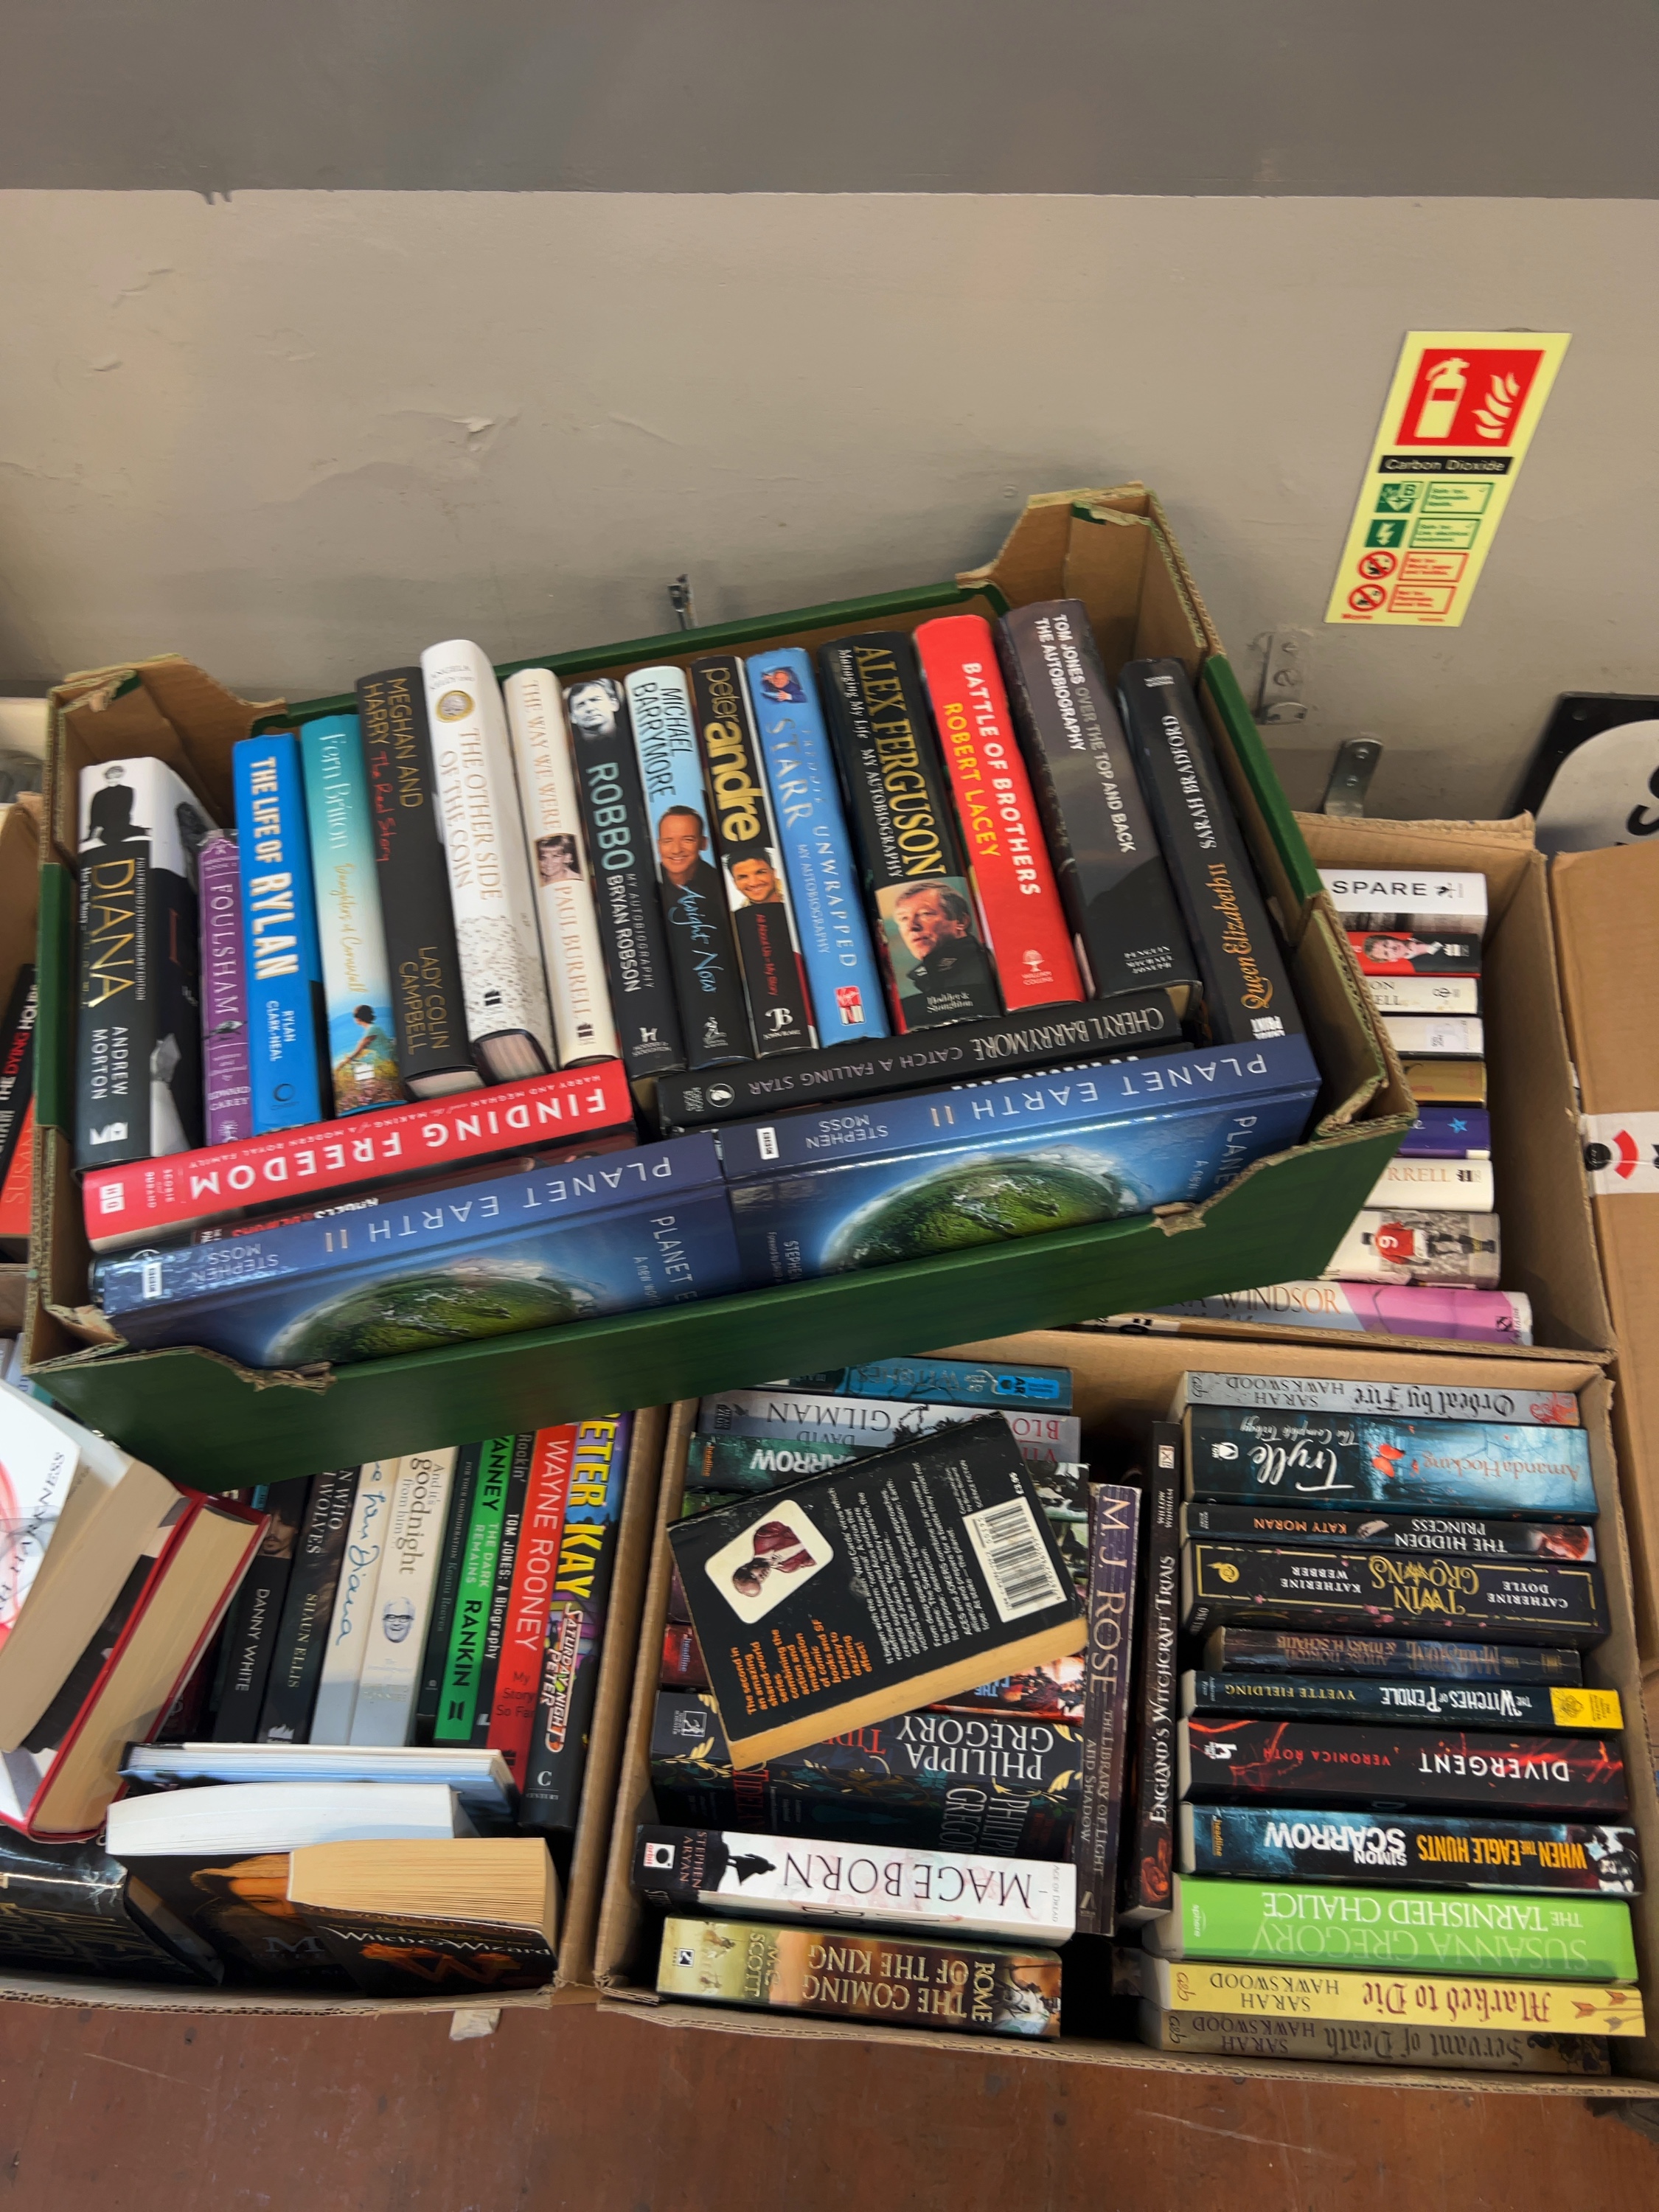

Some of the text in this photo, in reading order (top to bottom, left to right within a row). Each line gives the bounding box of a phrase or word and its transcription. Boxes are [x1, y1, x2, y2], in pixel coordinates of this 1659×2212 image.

[1384, 458, 1506, 472] Carbon Dioxide
[838, 650, 872, 739] Managing My Life
[1034, 617, 1087, 751] THE AUTOBIOGRAPHY
[362, 678, 424, 807] MEGHAN AND HARRY
[633, 682, 676, 803] BARRYMORE
[661, 688, 694, 753] MICHAEL
[1052, 613, 1136, 853] TOM JONES OVER THE TOP AND BACK
[853, 645, 947, 877] ALEX FERGUSON
[943, 702, 1001, 857] ROBERT LACEY
[962, 662, 1041, 895] BATTLE OF BROTHERS
[370, 751, 397, 862] The Real Story
[458, 728, 503, 900] THE OTHER SIDE
[586, 762, 636, 871] ROBBO
[860, 748, 904, 877] MY AUTOBIOGRAPHY
[250, 757, 299, 980] THE LIFE OF RYLAN
[1332, 880, 1428, 897] SPARE
[813, 826, 857, 967] UNWRAPPED
[88, 858, 136, 1008] DIANA
[210, 883, 239, 1014] FOULSHAM
[606, 874, 642, 992] BRYAN ROBSON
[398, 961, 428, 1055] CAMPBELL
[418, 946, 451, 1049] LADY COLIN
[282, 1010, 296, 1042] RYLAN
[970, 1007, 1164, 1061] CHERYL BARRYMORE
[4, 1032, 30, 1074] DYING
[91, 1029, 108, 1099] MORTON
[111, 1026, 129, 1095] ANDREW
[747, 1047, 964, 1095] CATCH A FALLING STAR
[189, 1088, 607, 1200] FINDING FREEDOM
[818, 1114, 870, 1133] MOSS
[1226, 1376, 1343, 1395] HAWKSWOOD
[1254, 1391, 1318, 1408] SARAH
[1354, 1386, 1515, 1416] Ordeal by Fire
[767, 1402, 891, 1431] GILMAN
[796, 1430, 855, 1446] DAVID
[703, 1441, 716, 1477] headline
[306, 1483, 335, 1554] WOLVES
[397, 1458, 432, 1575] goodnight
[1253, 1517, 1348, 1534] KATY MORAN
[1411, 1518, 1486, 1535] PRINCESS
[479, 1523, 499, 1588] THE DARK
[515, 1439, 571, 1651] WAYNE ROONEY
[1395, 1533, 1507, 1554] THE HIDDEN
[1090, 1496, 1131, 1694] M. J. ROSE
[1280, 1577, 1362, 1594] KATHERINE
[1292, 1565, 1349, 1579] WEBBER
[1502, 1580, 1549, 1595] DOYLE
[1486, 1593, 1569, 1609] CATHERINE
[234, 1587, 271, 1692] DANNY WHITE
[288, 1593, 319, 1689] SHAUN ELLIS
[452, 1599, 483, 1686] RANKIN
[795, 1632, 821, 1692] imagination
[843, 1635, 862, 1676] dazzling
[854, 1641, 873, 1672] effect!
[503, 1687, 535, 1703] Story
[513, 1672, 531, 1685] My
[732, 1658, 757, 1715] The second
[744, 1653, 763, 1696] amazing
[777, 1646, 799, 1699] combining
[1224, 1683, 1355, 1701] YVETTE FIELDING
[496, 1705, 536, 1718] So Far
[895, 1716, 1054, 1754] GREGORY
[904, 1742, 1043, 1781] PHILIPPA
[1419, 1752, 1569, 1783] DIVERGENT
[644, 1843, 655, 1867] orbit
[679, 1835, 692, 1884] ARYAN
[692, 1831, 708, 1890] STEPHEN
[1210, 1816, 1223, 1857] headline
[1264, 1822, 1406, 1854] SCARROW
[1417, 1834, 1588, 1870] WHEN THE EAGLE HUNTS
[783, 1851, 1032, 1909] MAGEBORN
[1193, 1904, 1202, 1938] sphere
[1262, 1891, 1584, 1932] THE TARNISHED CHALICE
[317, 1925, 552, 1956] Witch Wizard
[742, 1933, 766, 1997] SCOTT
[807, 1944, 970, 1986] OF THE KING
[1209, 1972, 1340, 1995] HAWKSWOOD
[801, 1975, 967, 2020] THE COMING
[971, 1961, 995, 2024] ROME
[1242, 1992, 1312, 2012] SARAH
[1362, 1981, 1552, 2023] Marked to Die
